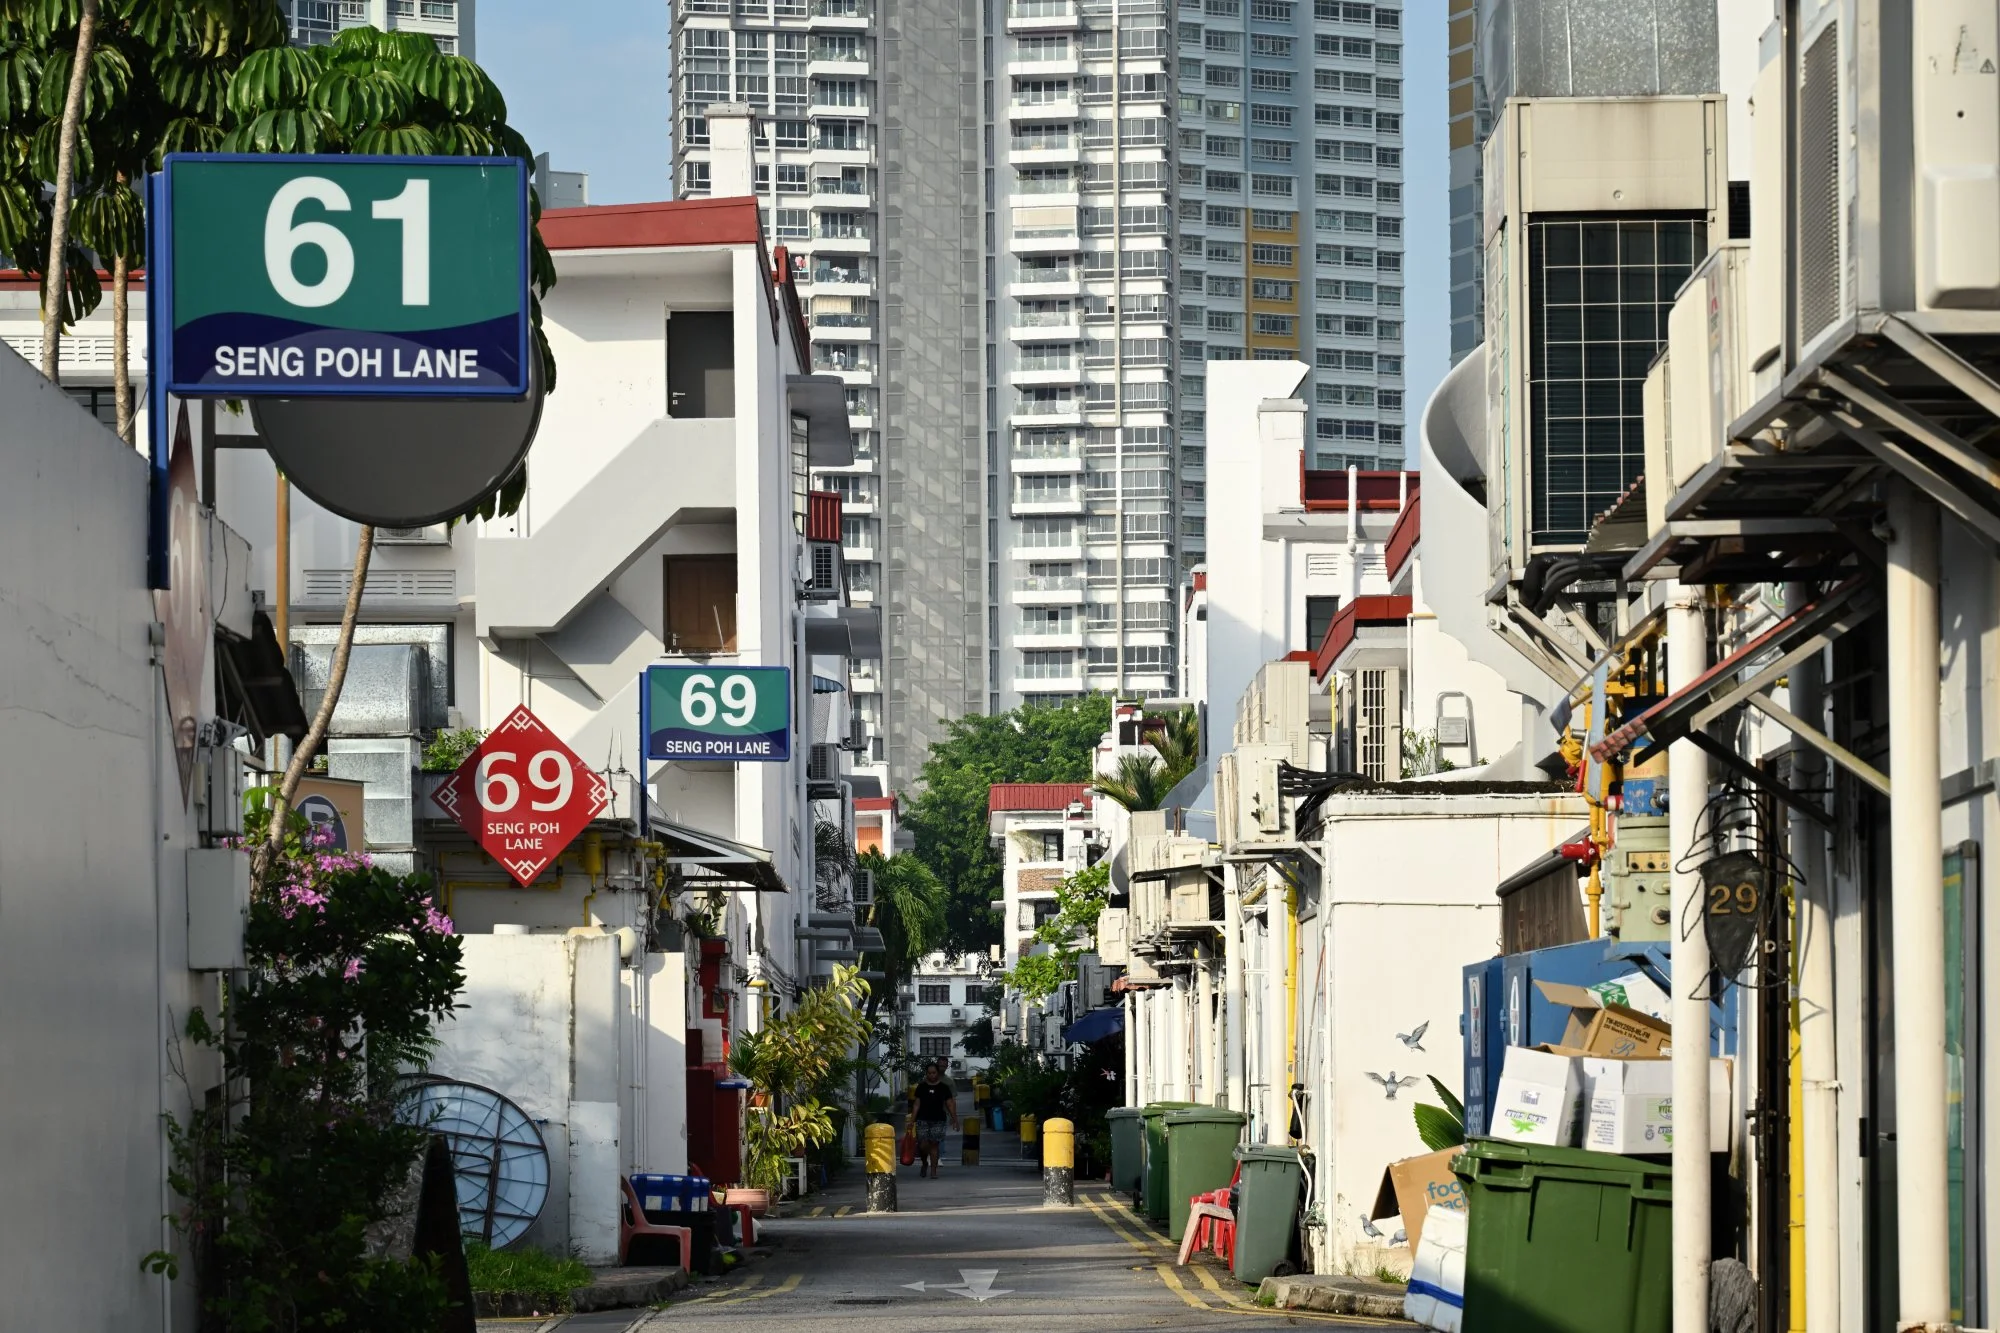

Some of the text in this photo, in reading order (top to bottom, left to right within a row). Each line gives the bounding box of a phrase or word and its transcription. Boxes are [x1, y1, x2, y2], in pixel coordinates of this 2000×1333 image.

[264, 176, 430, 308] 61
[214, 345, 479, 378] SENG POH LANE
[169, 486, 197, 638] 61
[680, 673, 757, 727] 69
[666, 740, 771, 754] SENG POH LANE
[474, 750, 574, 813] 69
[487, 822, 560, 835] SENG POH
[505, 838, 543, 850] LANE
[1709, 883, 1759, 915] 29
[1427, 1181, 1463, 1200] foo
